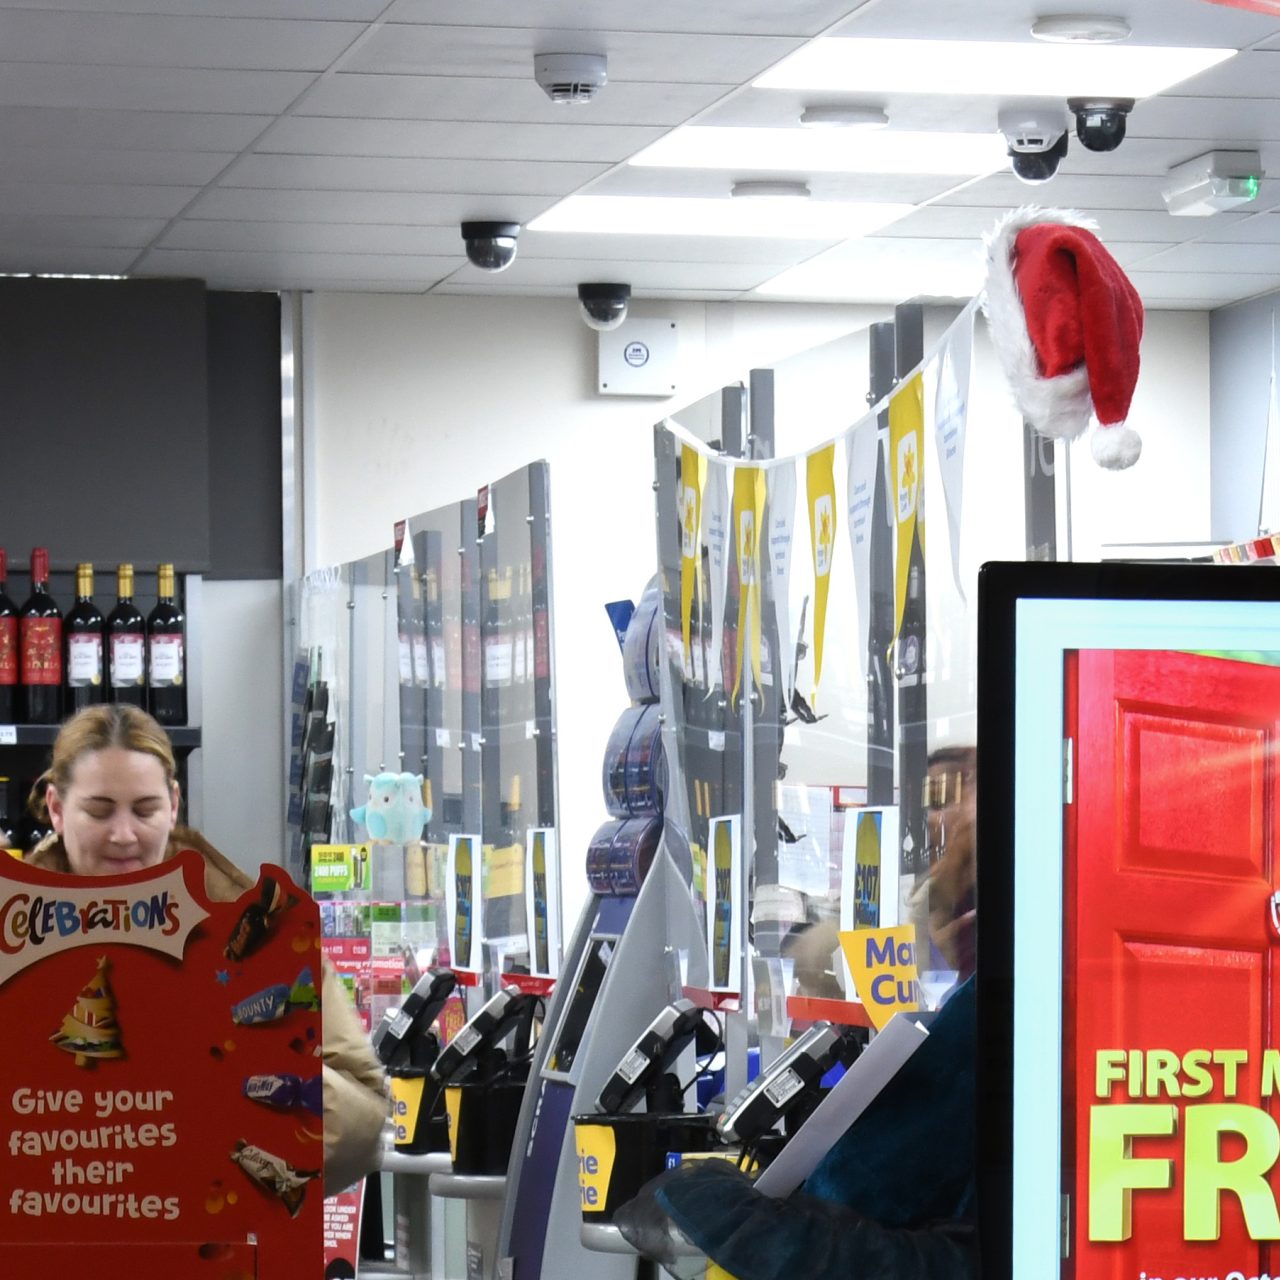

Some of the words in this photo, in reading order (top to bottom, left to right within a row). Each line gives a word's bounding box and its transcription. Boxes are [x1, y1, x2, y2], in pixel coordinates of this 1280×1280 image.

[866, 936, 916, 969] Ma
[1095, 1048, 1248, 1097] FIRST
[12, 1088, 83, 1115] Give
[95, 1088, 174, 1118] your
[8, 1123, 177, 1156] favourites
[52, 1159, 135, 1185] their
[9, 1190, 181, 1220] favourites
